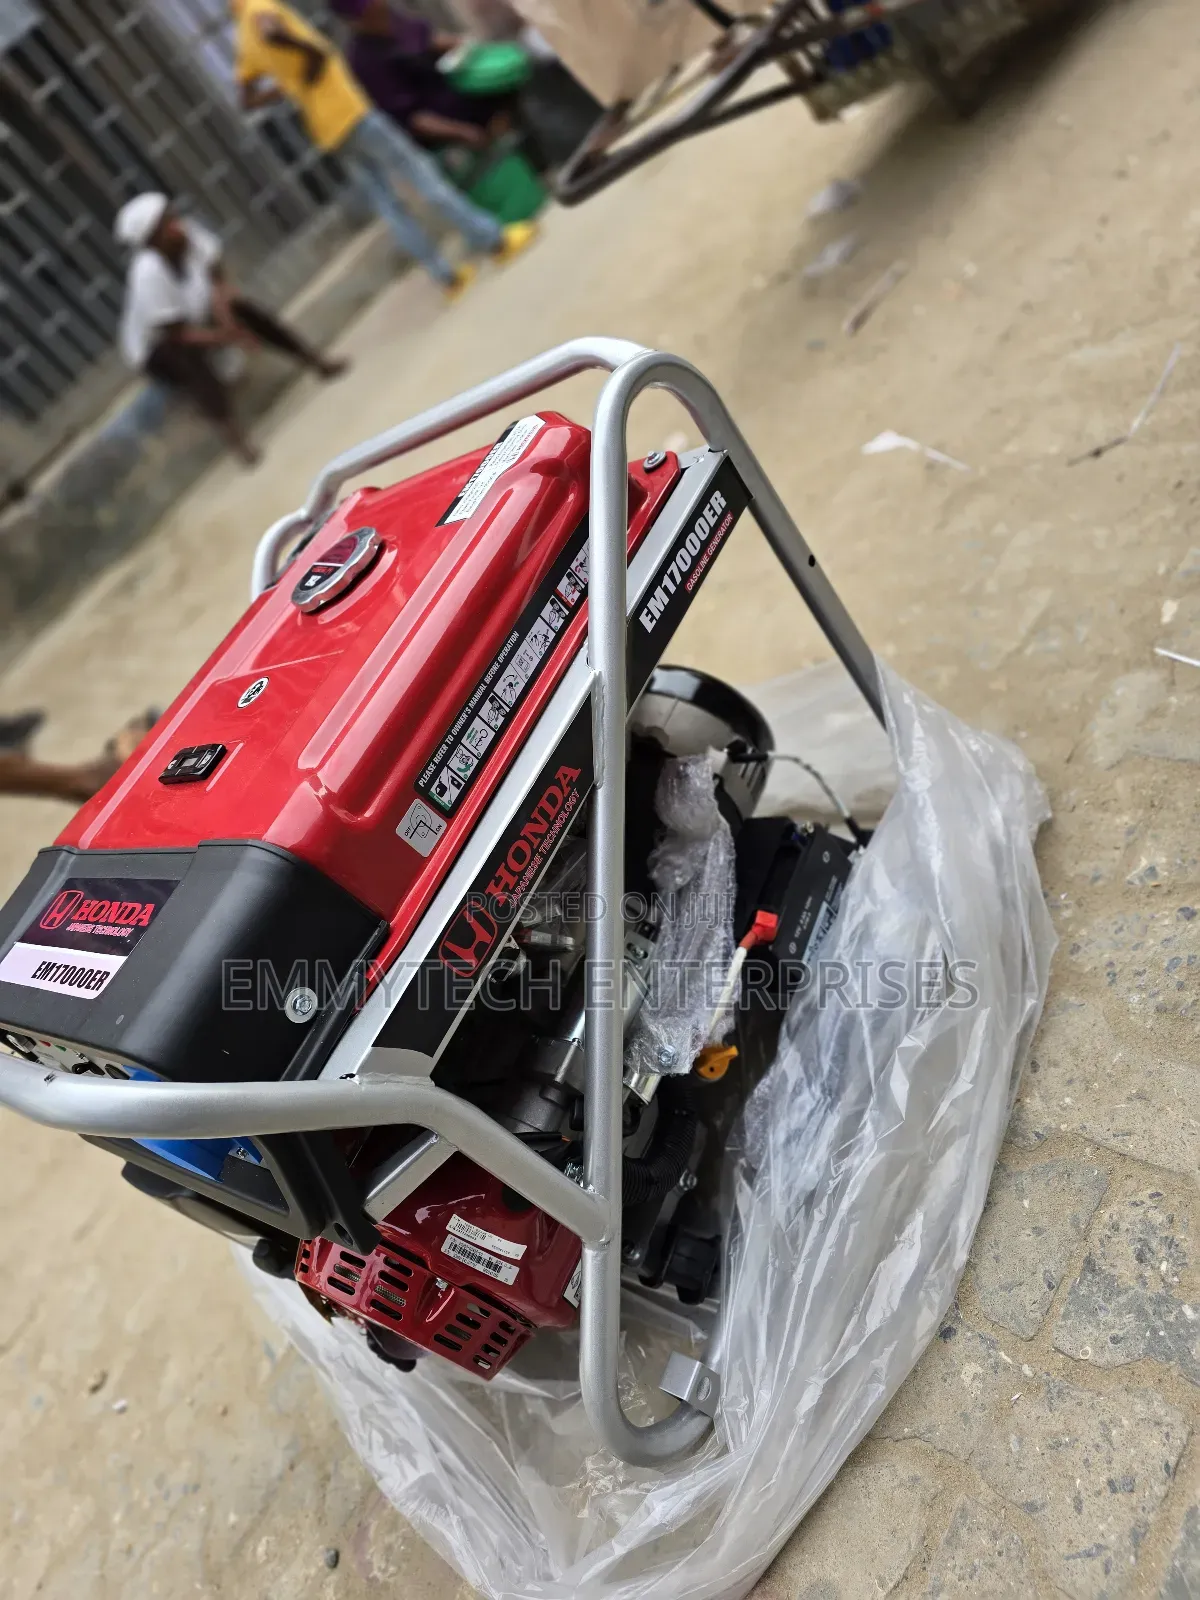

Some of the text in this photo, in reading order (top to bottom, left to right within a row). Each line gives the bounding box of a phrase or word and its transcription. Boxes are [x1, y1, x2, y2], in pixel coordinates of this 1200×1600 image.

[638, 490, 727, 634] EM17000ER
[686, 513, 734, 591] GASOLINE GENERATOR
[418, 630, 520, 788] PLEASE REFER TO OWNER'S MANUAL BEFORE OPERATION
[435, 824, 443, 834] ON
[484, 765, 582, 908] HONDA
[508, 787, 581, 909] JAPANESE TECHNOLOGY
[71, 899, 155, 927] HONDA
[31, 960, 111, 992] EM17000ER
